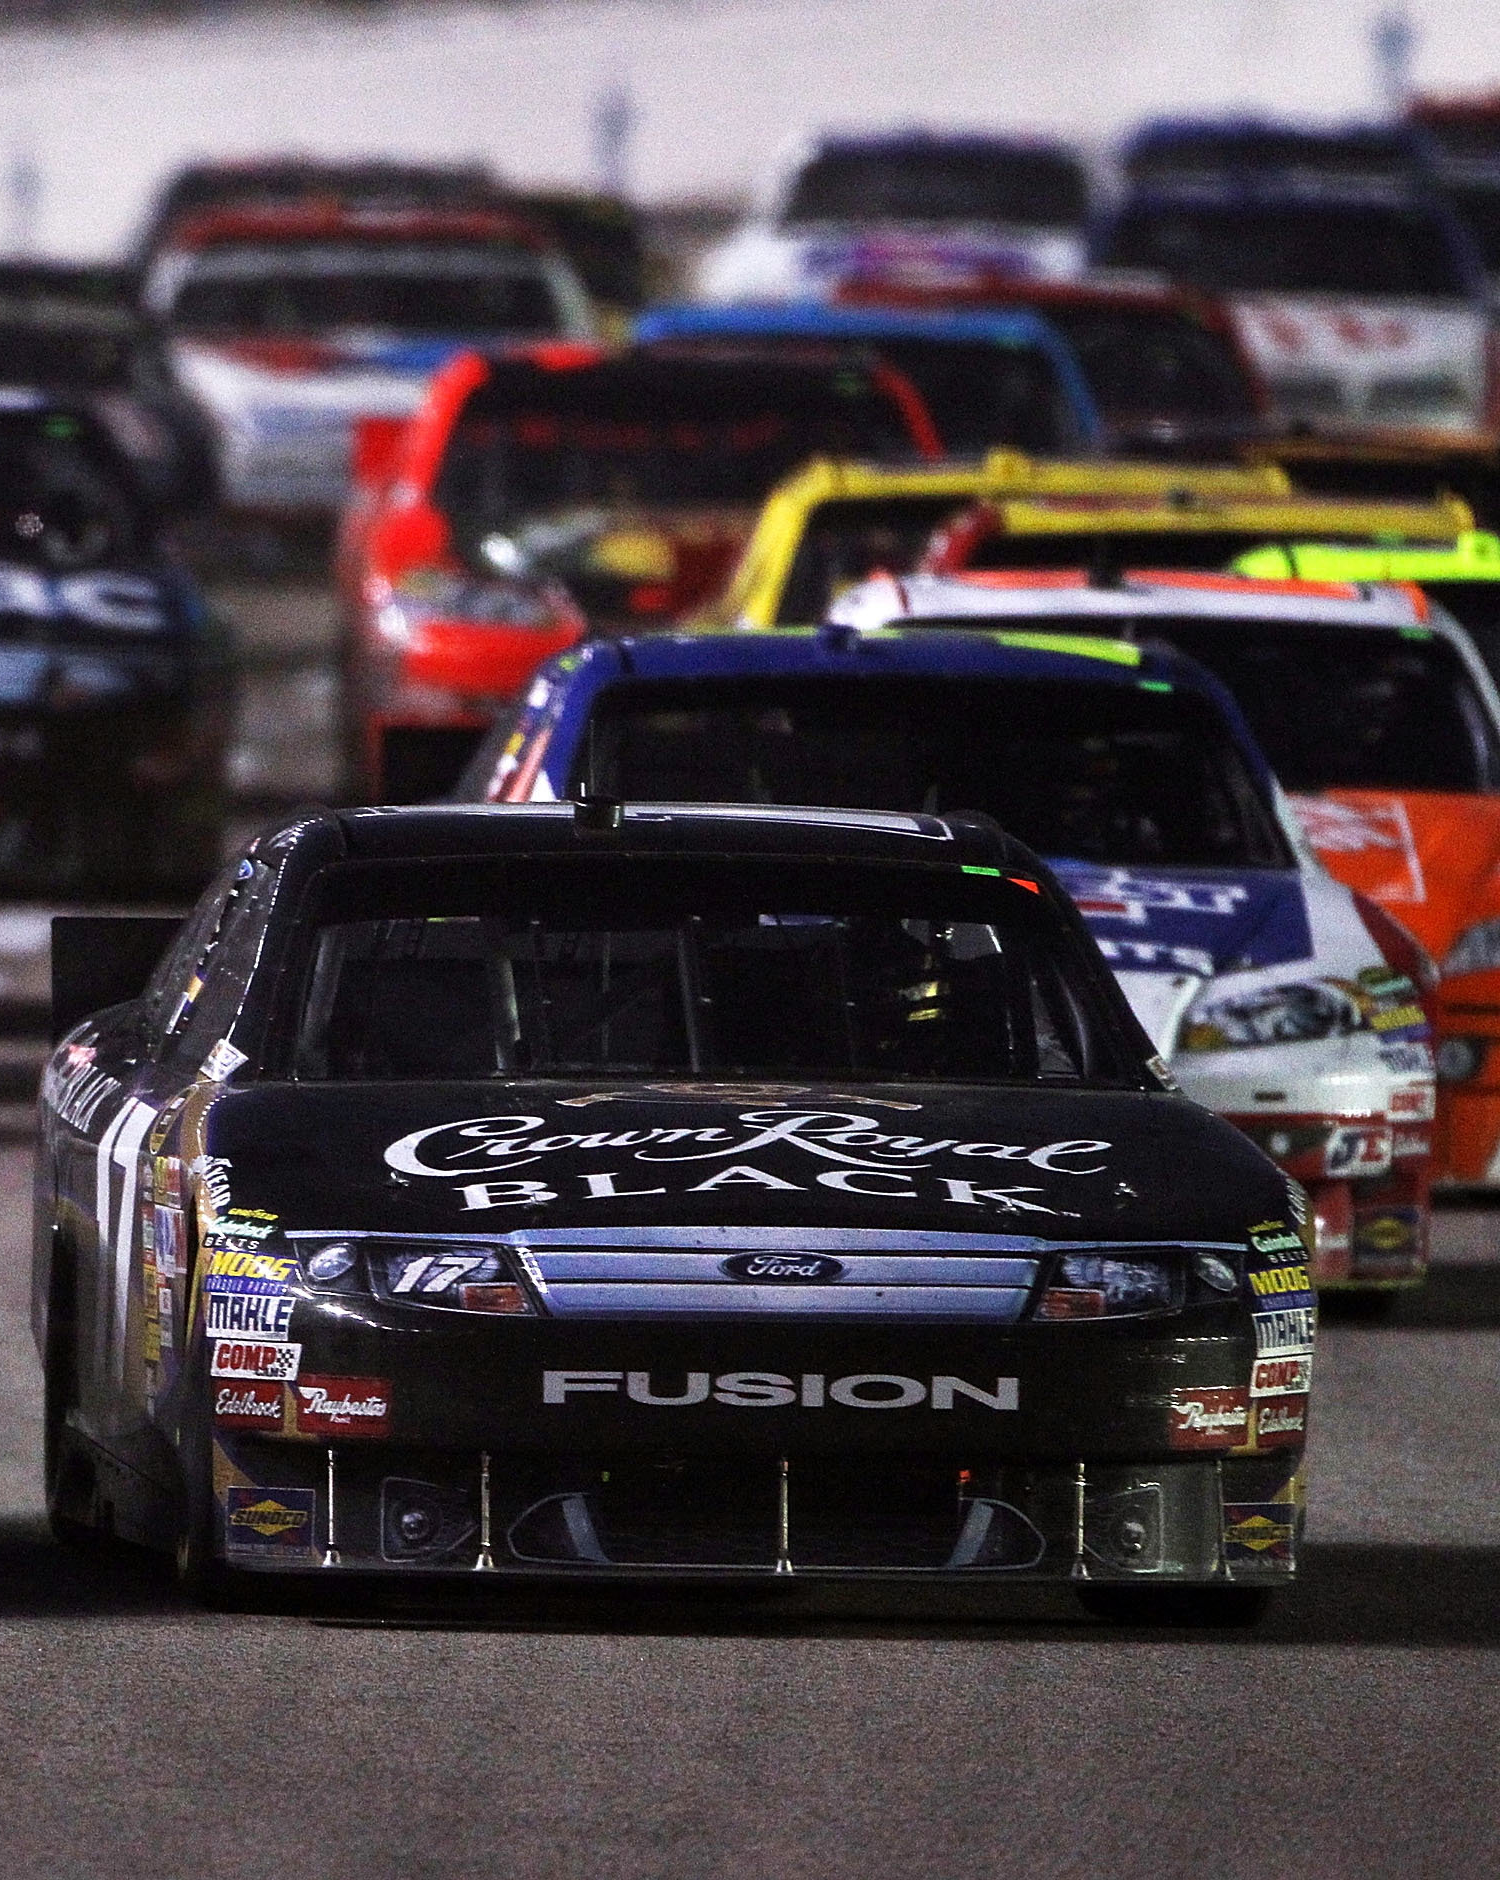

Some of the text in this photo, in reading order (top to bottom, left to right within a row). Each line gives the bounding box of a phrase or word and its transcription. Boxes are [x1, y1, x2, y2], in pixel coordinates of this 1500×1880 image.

[384, 1110, 1113, 1177] Crown Royal
[453, 1165, 1081, 1217] BLACK
[211, 1251, 298, 1281] MOOG
[392, 1257, 485, 1292] 17
[747, 1254, 821, 1278] Ford
[1250, 1266, 1311, 1296] MOOG
[208, 1298, 295, 1333] MAHLE
[216, 1343, 277, 1370] COMP
[215, 1386, 388, 1419] Edelbrock Raybestos
[543, 1371, 1019, 1410] FUSION
[233, 1510, 306, 1526] SUNOCO
